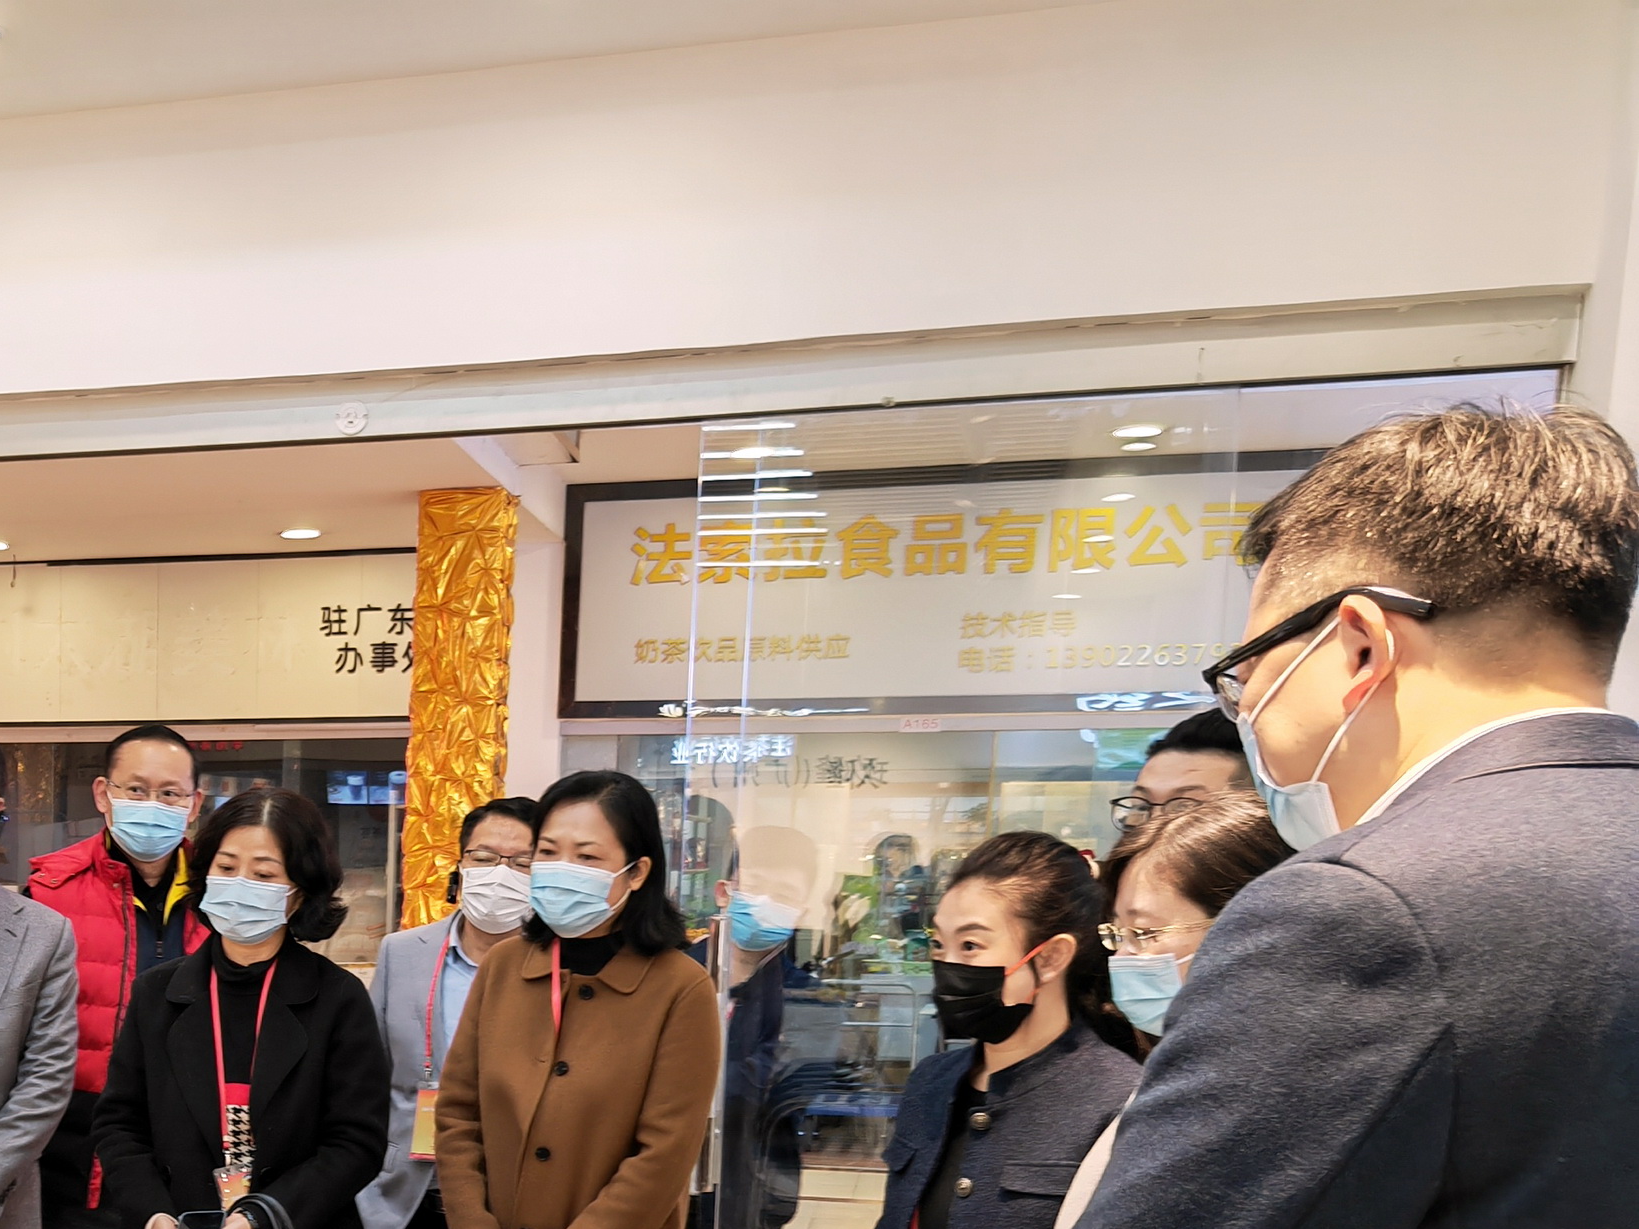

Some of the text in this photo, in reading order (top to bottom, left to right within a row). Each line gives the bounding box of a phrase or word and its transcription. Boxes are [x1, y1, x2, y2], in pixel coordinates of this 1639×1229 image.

[319, 603, 415, 637] 驻广东
[960, 610, 1078, 640] 技术指导
[633, 633, 852, 665] 奶茶饮品原料供应
[903, 718, 939, 730] A165
